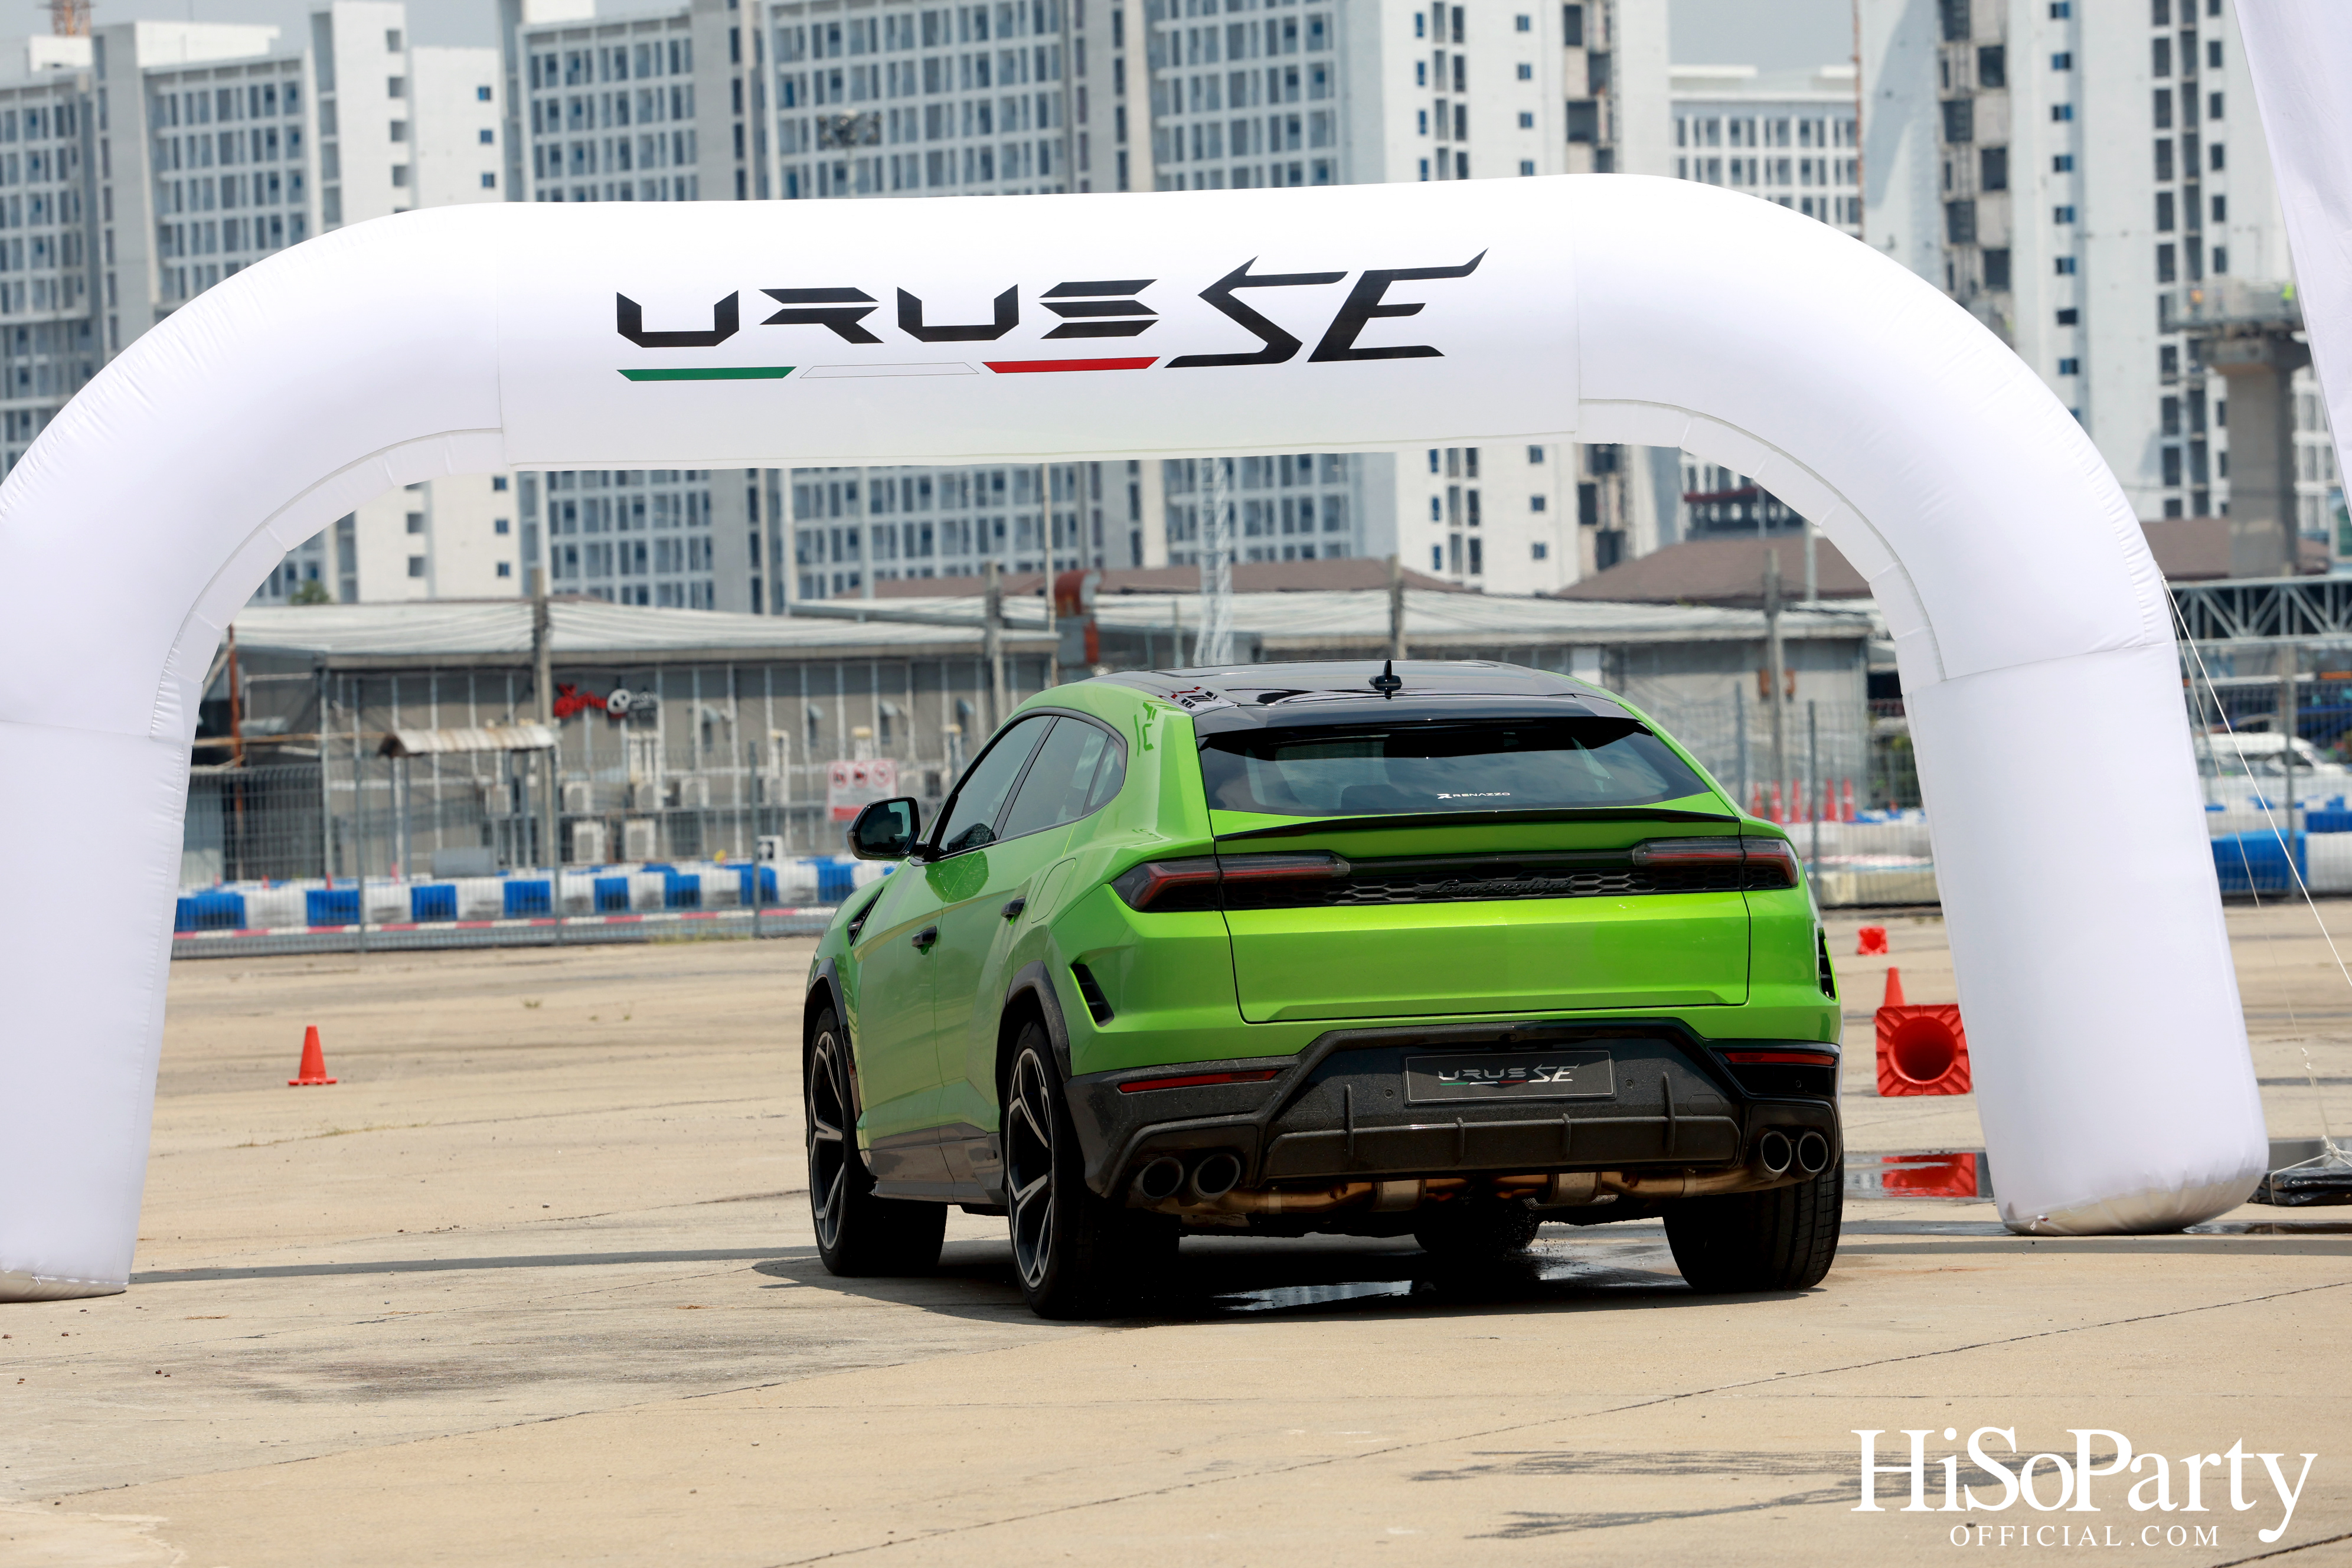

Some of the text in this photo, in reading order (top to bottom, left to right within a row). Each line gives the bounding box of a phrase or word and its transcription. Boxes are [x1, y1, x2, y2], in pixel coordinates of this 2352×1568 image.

[616, 247, 1489, 367] URUS SE
[1419, 877, 1572, 897] Lamborghini
[1438, 1063, 1580, 1083] URUS SE
